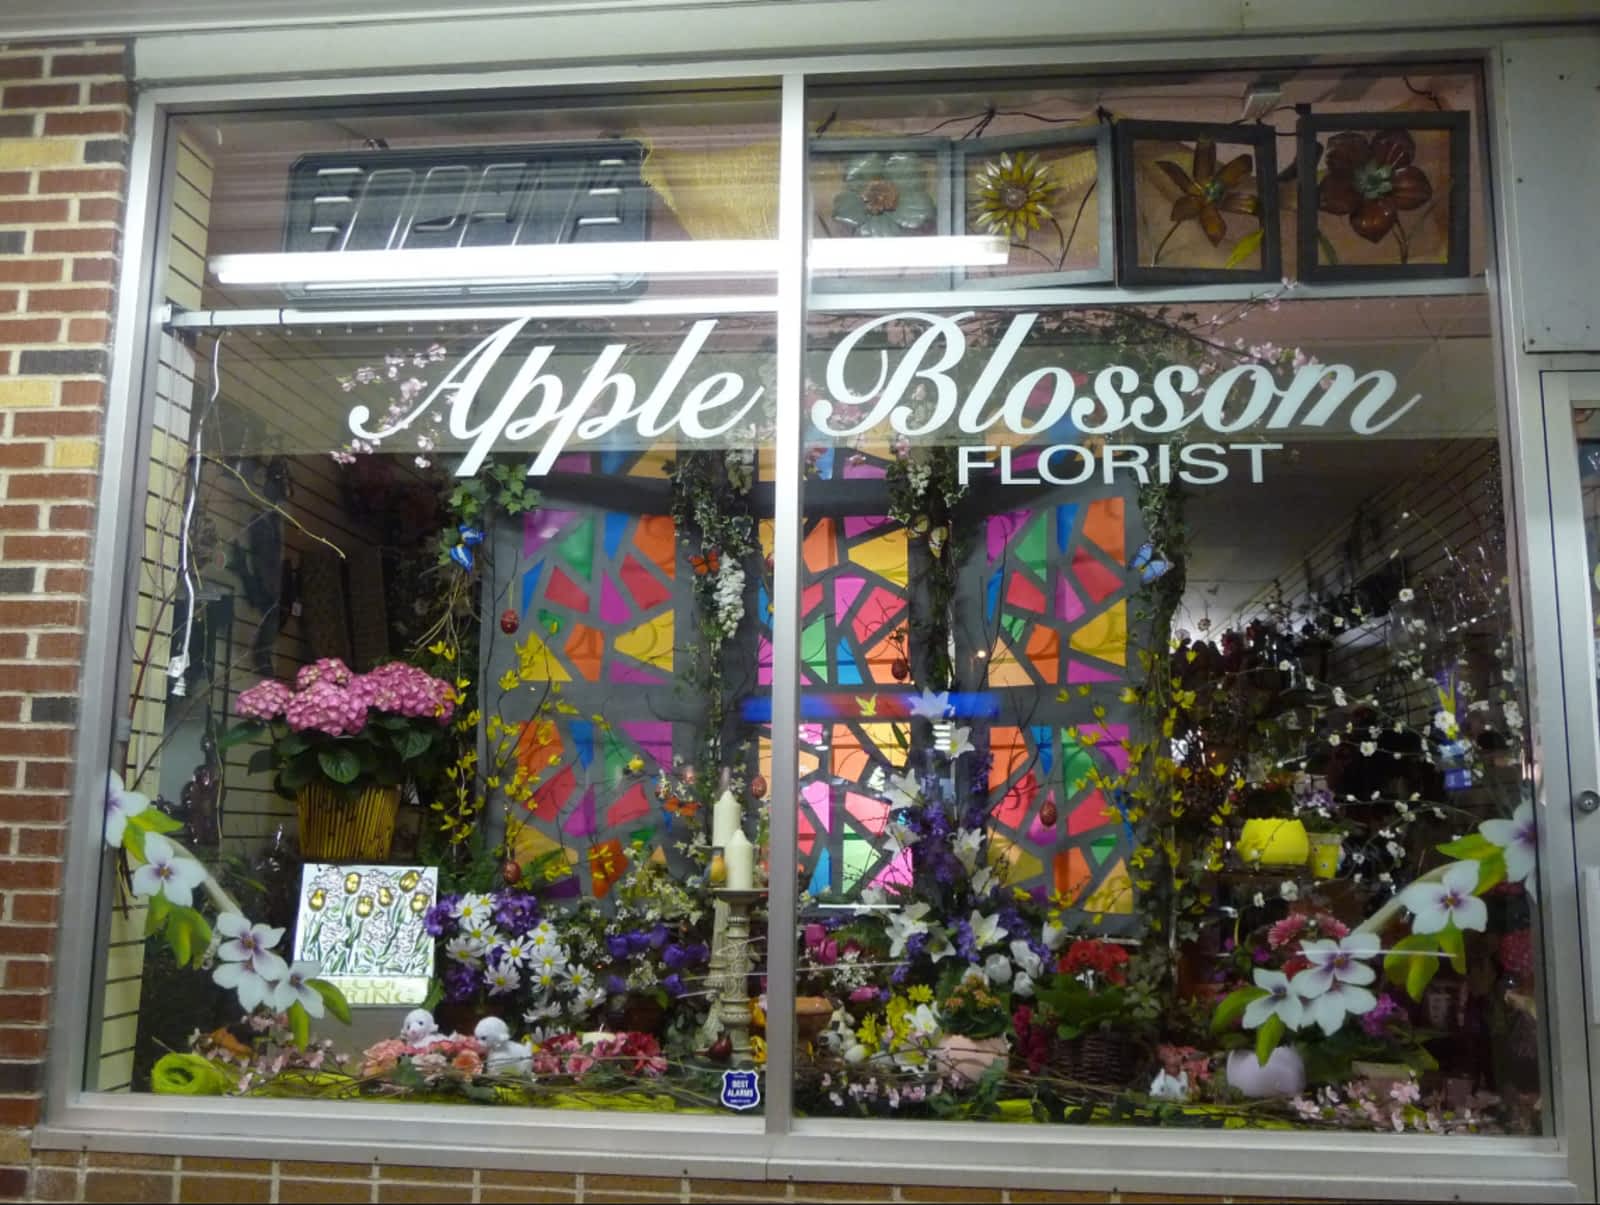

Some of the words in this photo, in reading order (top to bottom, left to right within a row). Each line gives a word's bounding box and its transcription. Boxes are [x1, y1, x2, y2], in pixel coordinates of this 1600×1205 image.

[348, 316, 764, 477] Apple
[812, 311, 1422, 437] Blossom
[957, 443, 1283, 485] FLORIST
